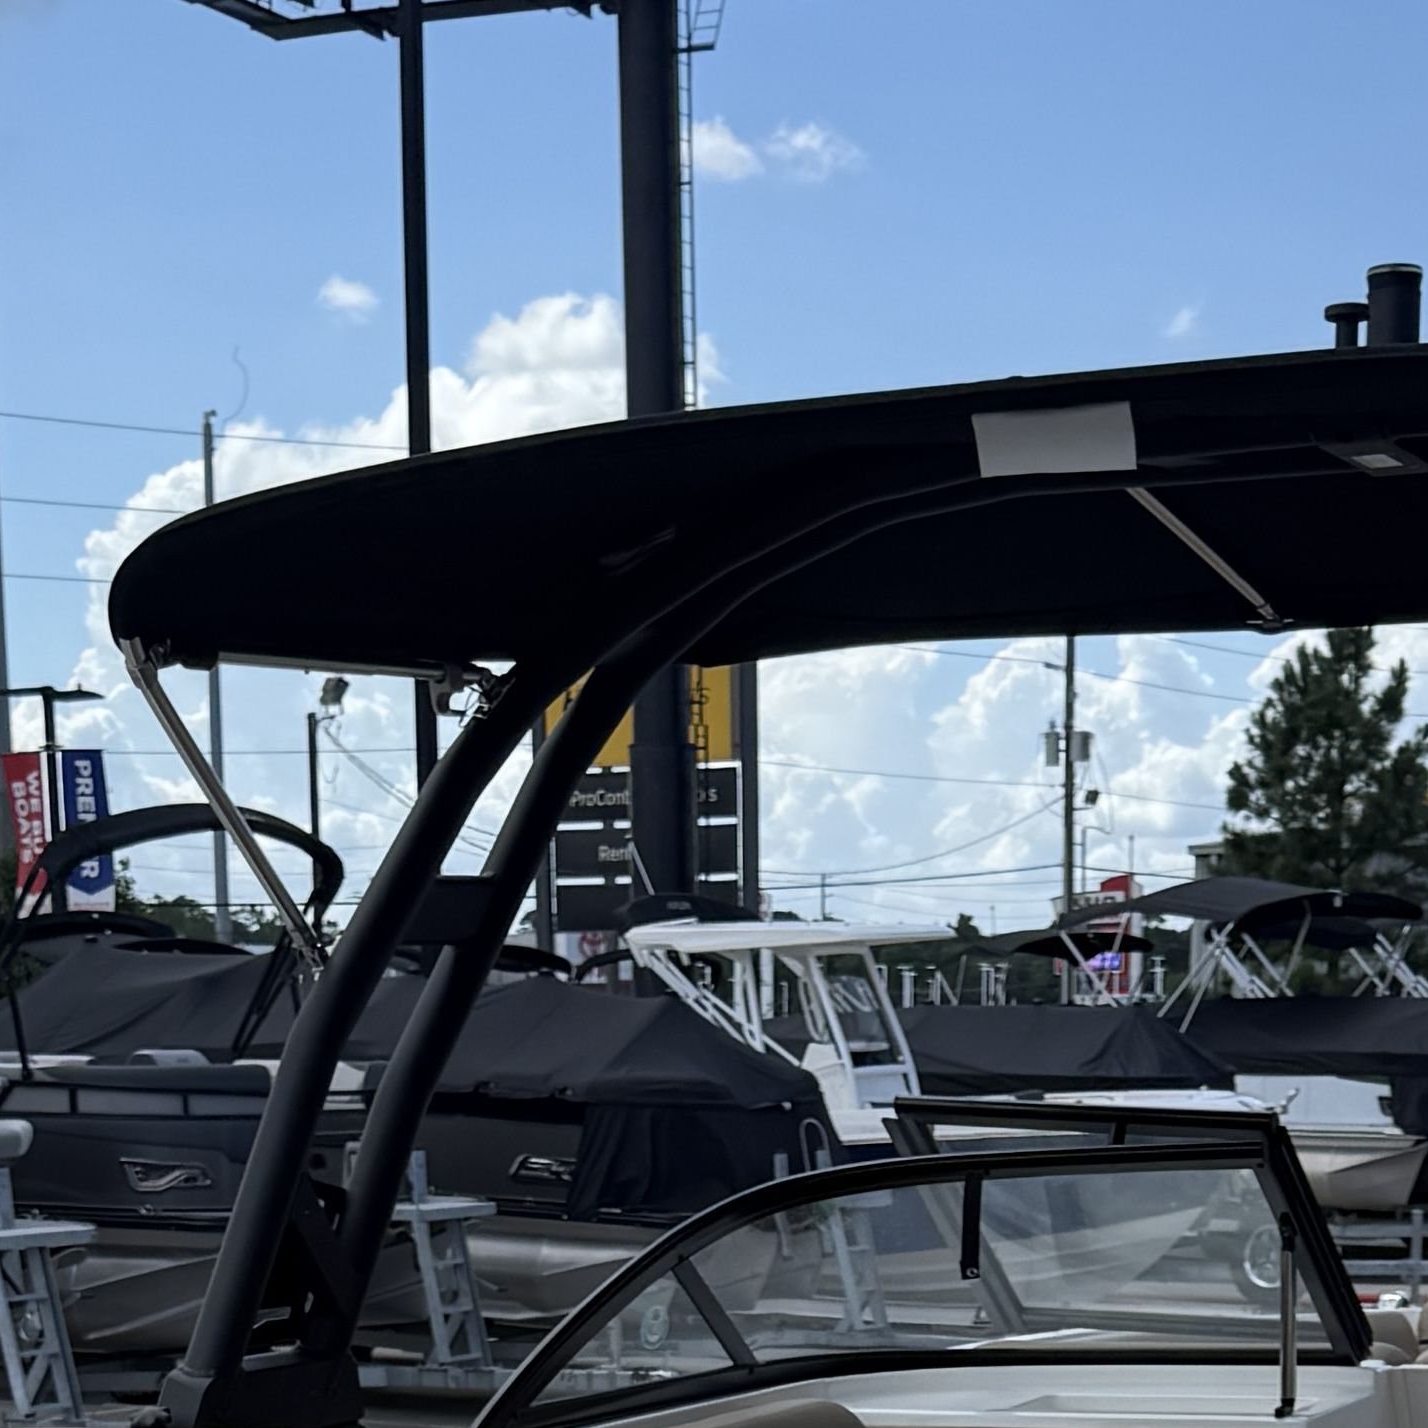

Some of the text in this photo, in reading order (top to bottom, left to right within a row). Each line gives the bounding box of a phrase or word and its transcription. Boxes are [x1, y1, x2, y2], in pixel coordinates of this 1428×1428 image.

[11, 781, 34, 863] BOATS
[26, 770, 44, 855] WE BU
